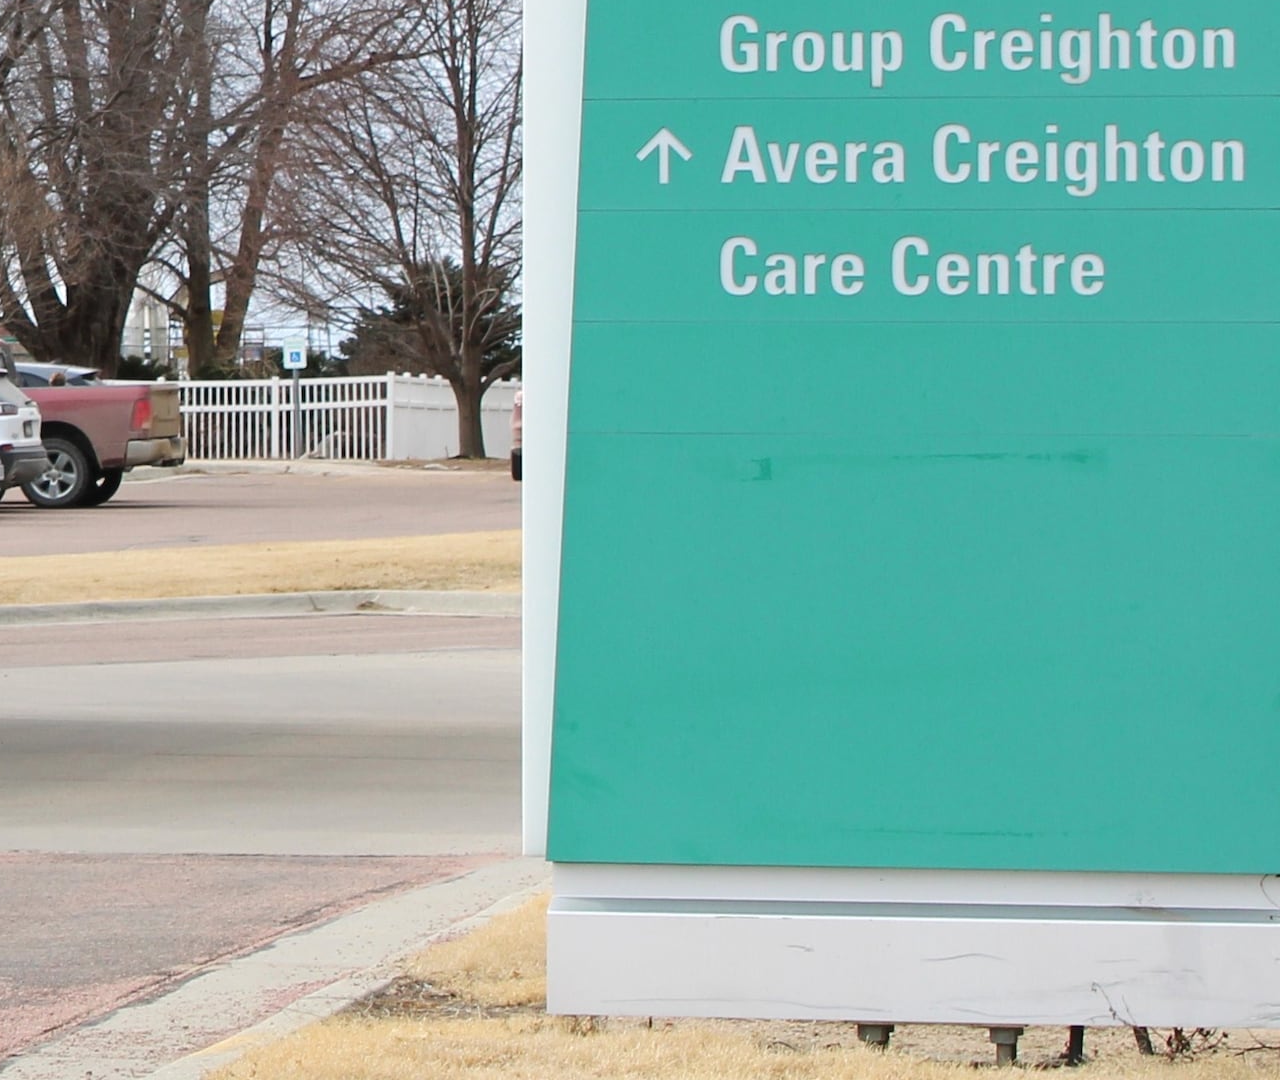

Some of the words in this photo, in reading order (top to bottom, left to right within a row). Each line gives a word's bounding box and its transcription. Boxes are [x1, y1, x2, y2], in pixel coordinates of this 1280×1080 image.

[720, 15, 904, 88] Group
[929, 13, 1236, 84] Creighton
[721, 126, 905, 184] Avera
[933, 124, 1246, 197] Creighton
[720, 236, 865, 296] Care
[892, 236, 1105, 296] Centre
